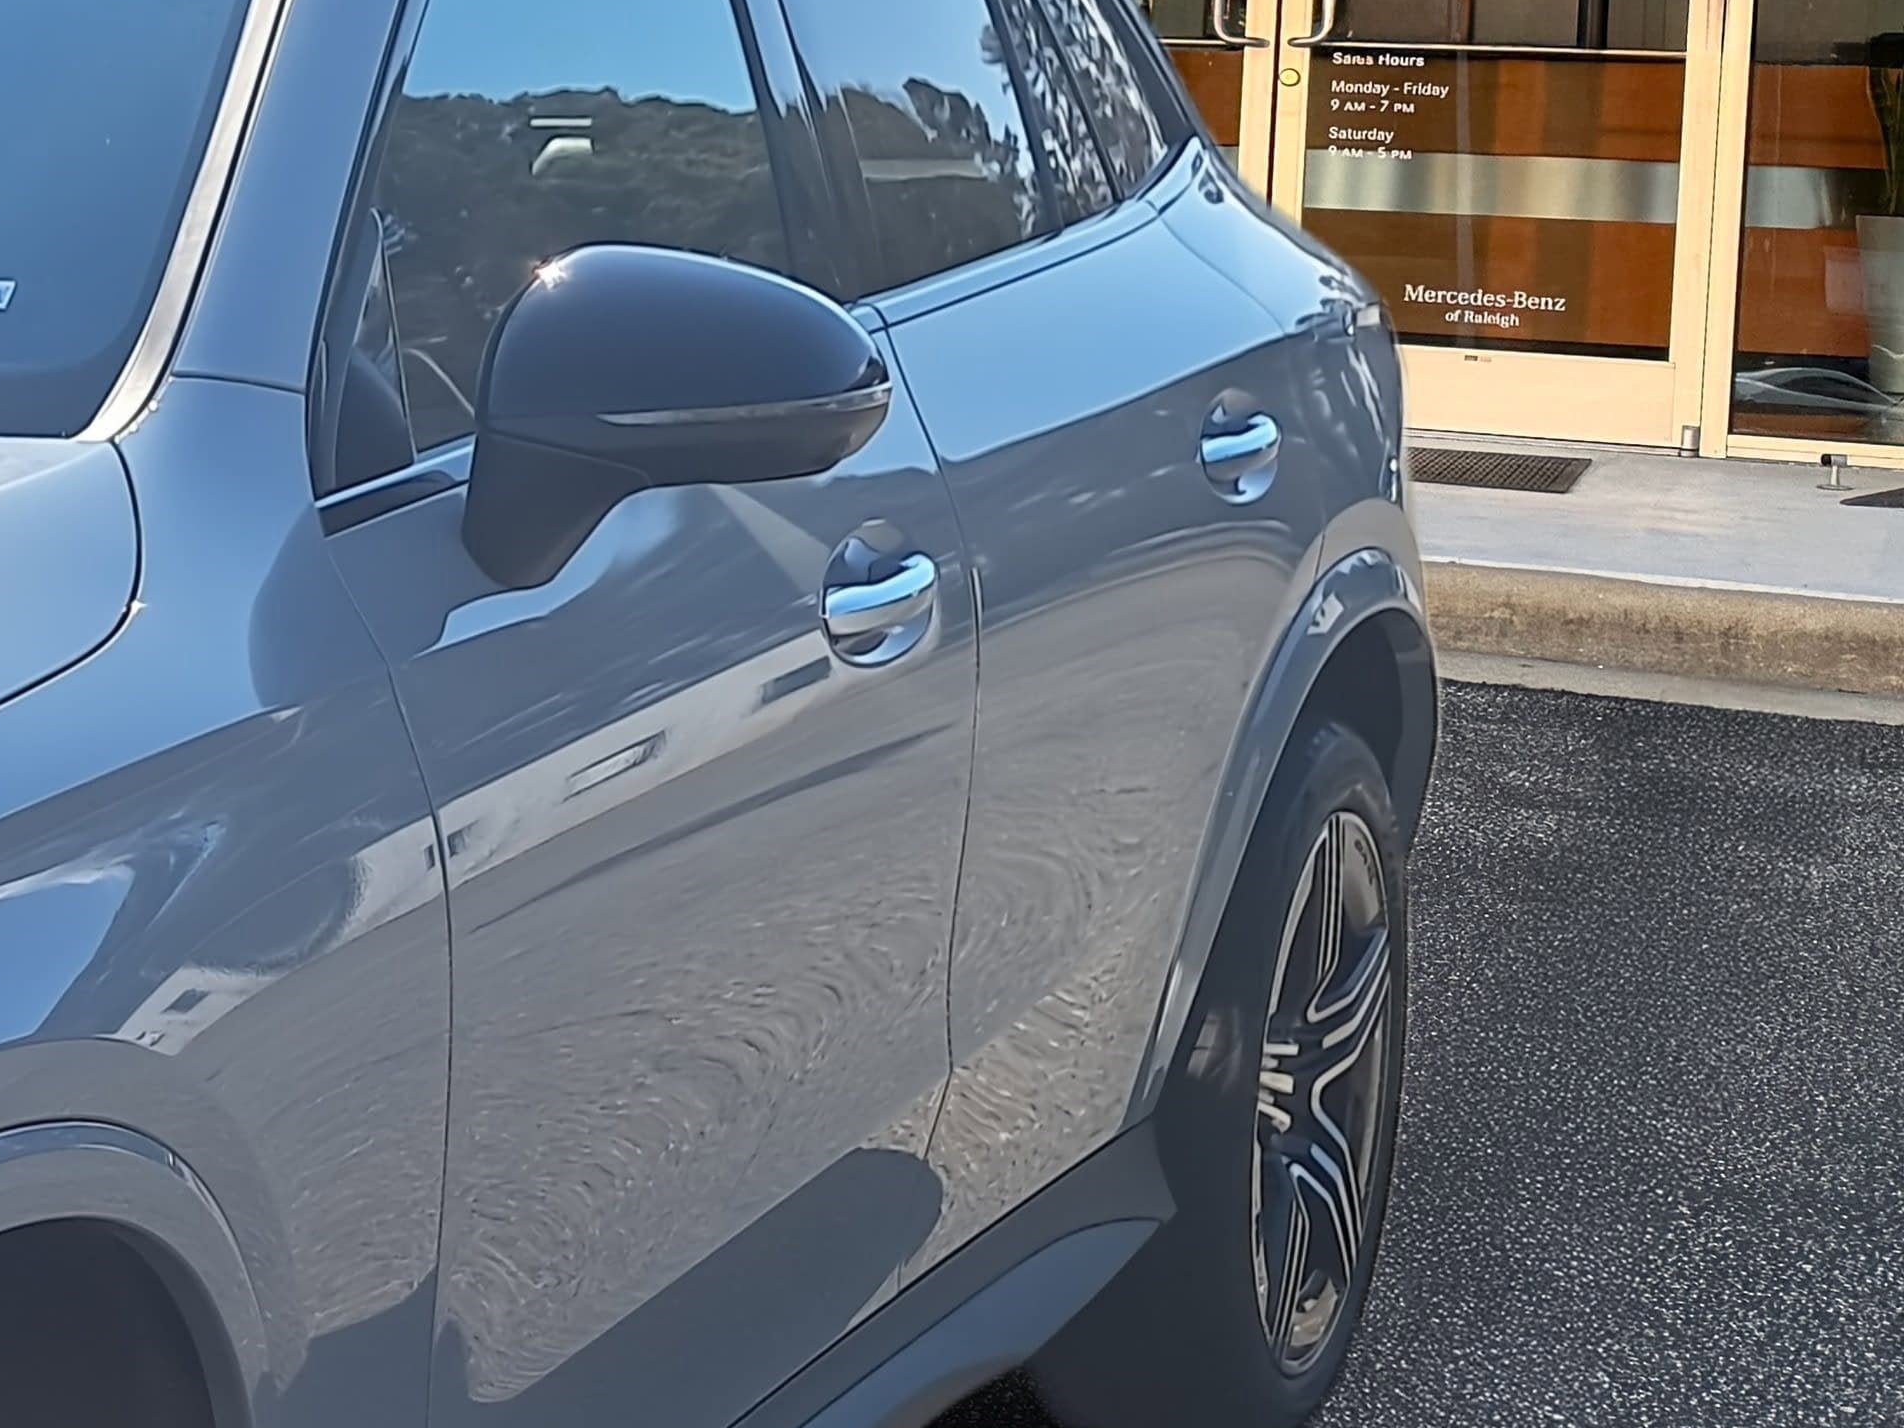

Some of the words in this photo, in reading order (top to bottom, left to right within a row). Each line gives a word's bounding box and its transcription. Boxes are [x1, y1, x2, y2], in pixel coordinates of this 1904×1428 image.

[1378, 53, 1425, 67] Hours
[1331, 80, 1390, 97] Monday
[1403, 82, 1450, 99] Friday
[1330, 99, 1340, 112] 9
[1344, 102, 1366, 112] AM
[1379, 100, 1389, 112] 7
[1393, 103, 1415, 113] PM
[1328, 127, 1394, 144] Saturday
[1328, 145, 1337, 157] 9
[1342, 148, 1364, 158] AM
[1377, 147, 1387, 158] 5
[1391, 150, 1412, 160] PM
[1403, 283, 1566, 311] Mercedes-Benz
[1445, 309, 1463, 322] of
[1463, 310, 1520, 328] Raleigh
